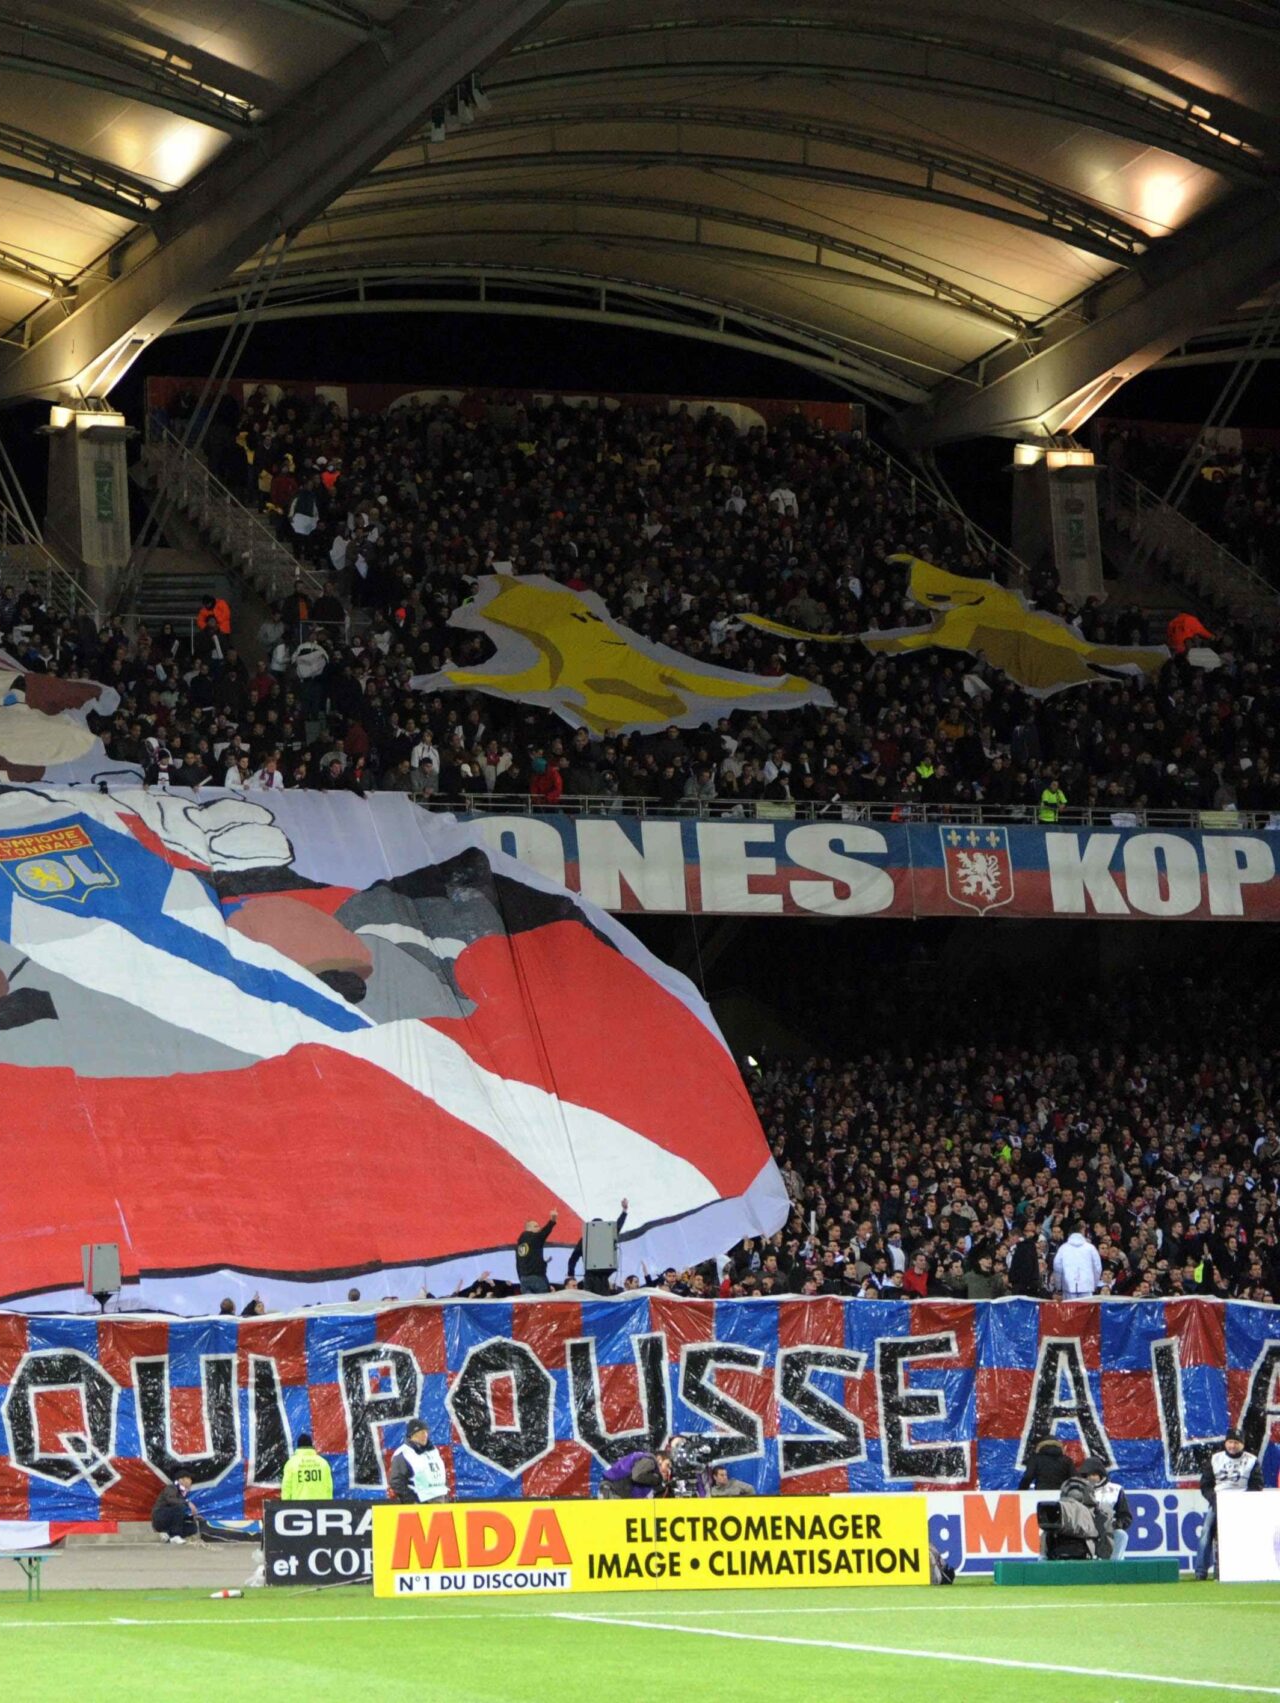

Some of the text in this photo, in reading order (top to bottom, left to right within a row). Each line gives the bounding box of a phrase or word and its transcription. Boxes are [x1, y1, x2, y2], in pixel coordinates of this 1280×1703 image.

[1045, 831, 1276, 916] KOP
[1, 1347, 294, 1496] QUI
[336, 1331, 972, 1491] POUSSE
[1015, 1336, 1119, 1472] A
[304, 1469, 322, 1482] 301
[391, 1508, 574, 1570] MDA
[625, 1513, 882, 1543] ELECTROMENAGER
[273, 1555, 299, 1576] et
[588, 1547, 921, 1579] IMAGE CLIMATISATION
[440, 1574, 466, 1590] DU
[473, 1571, 568, 1589] DISCOUNT
